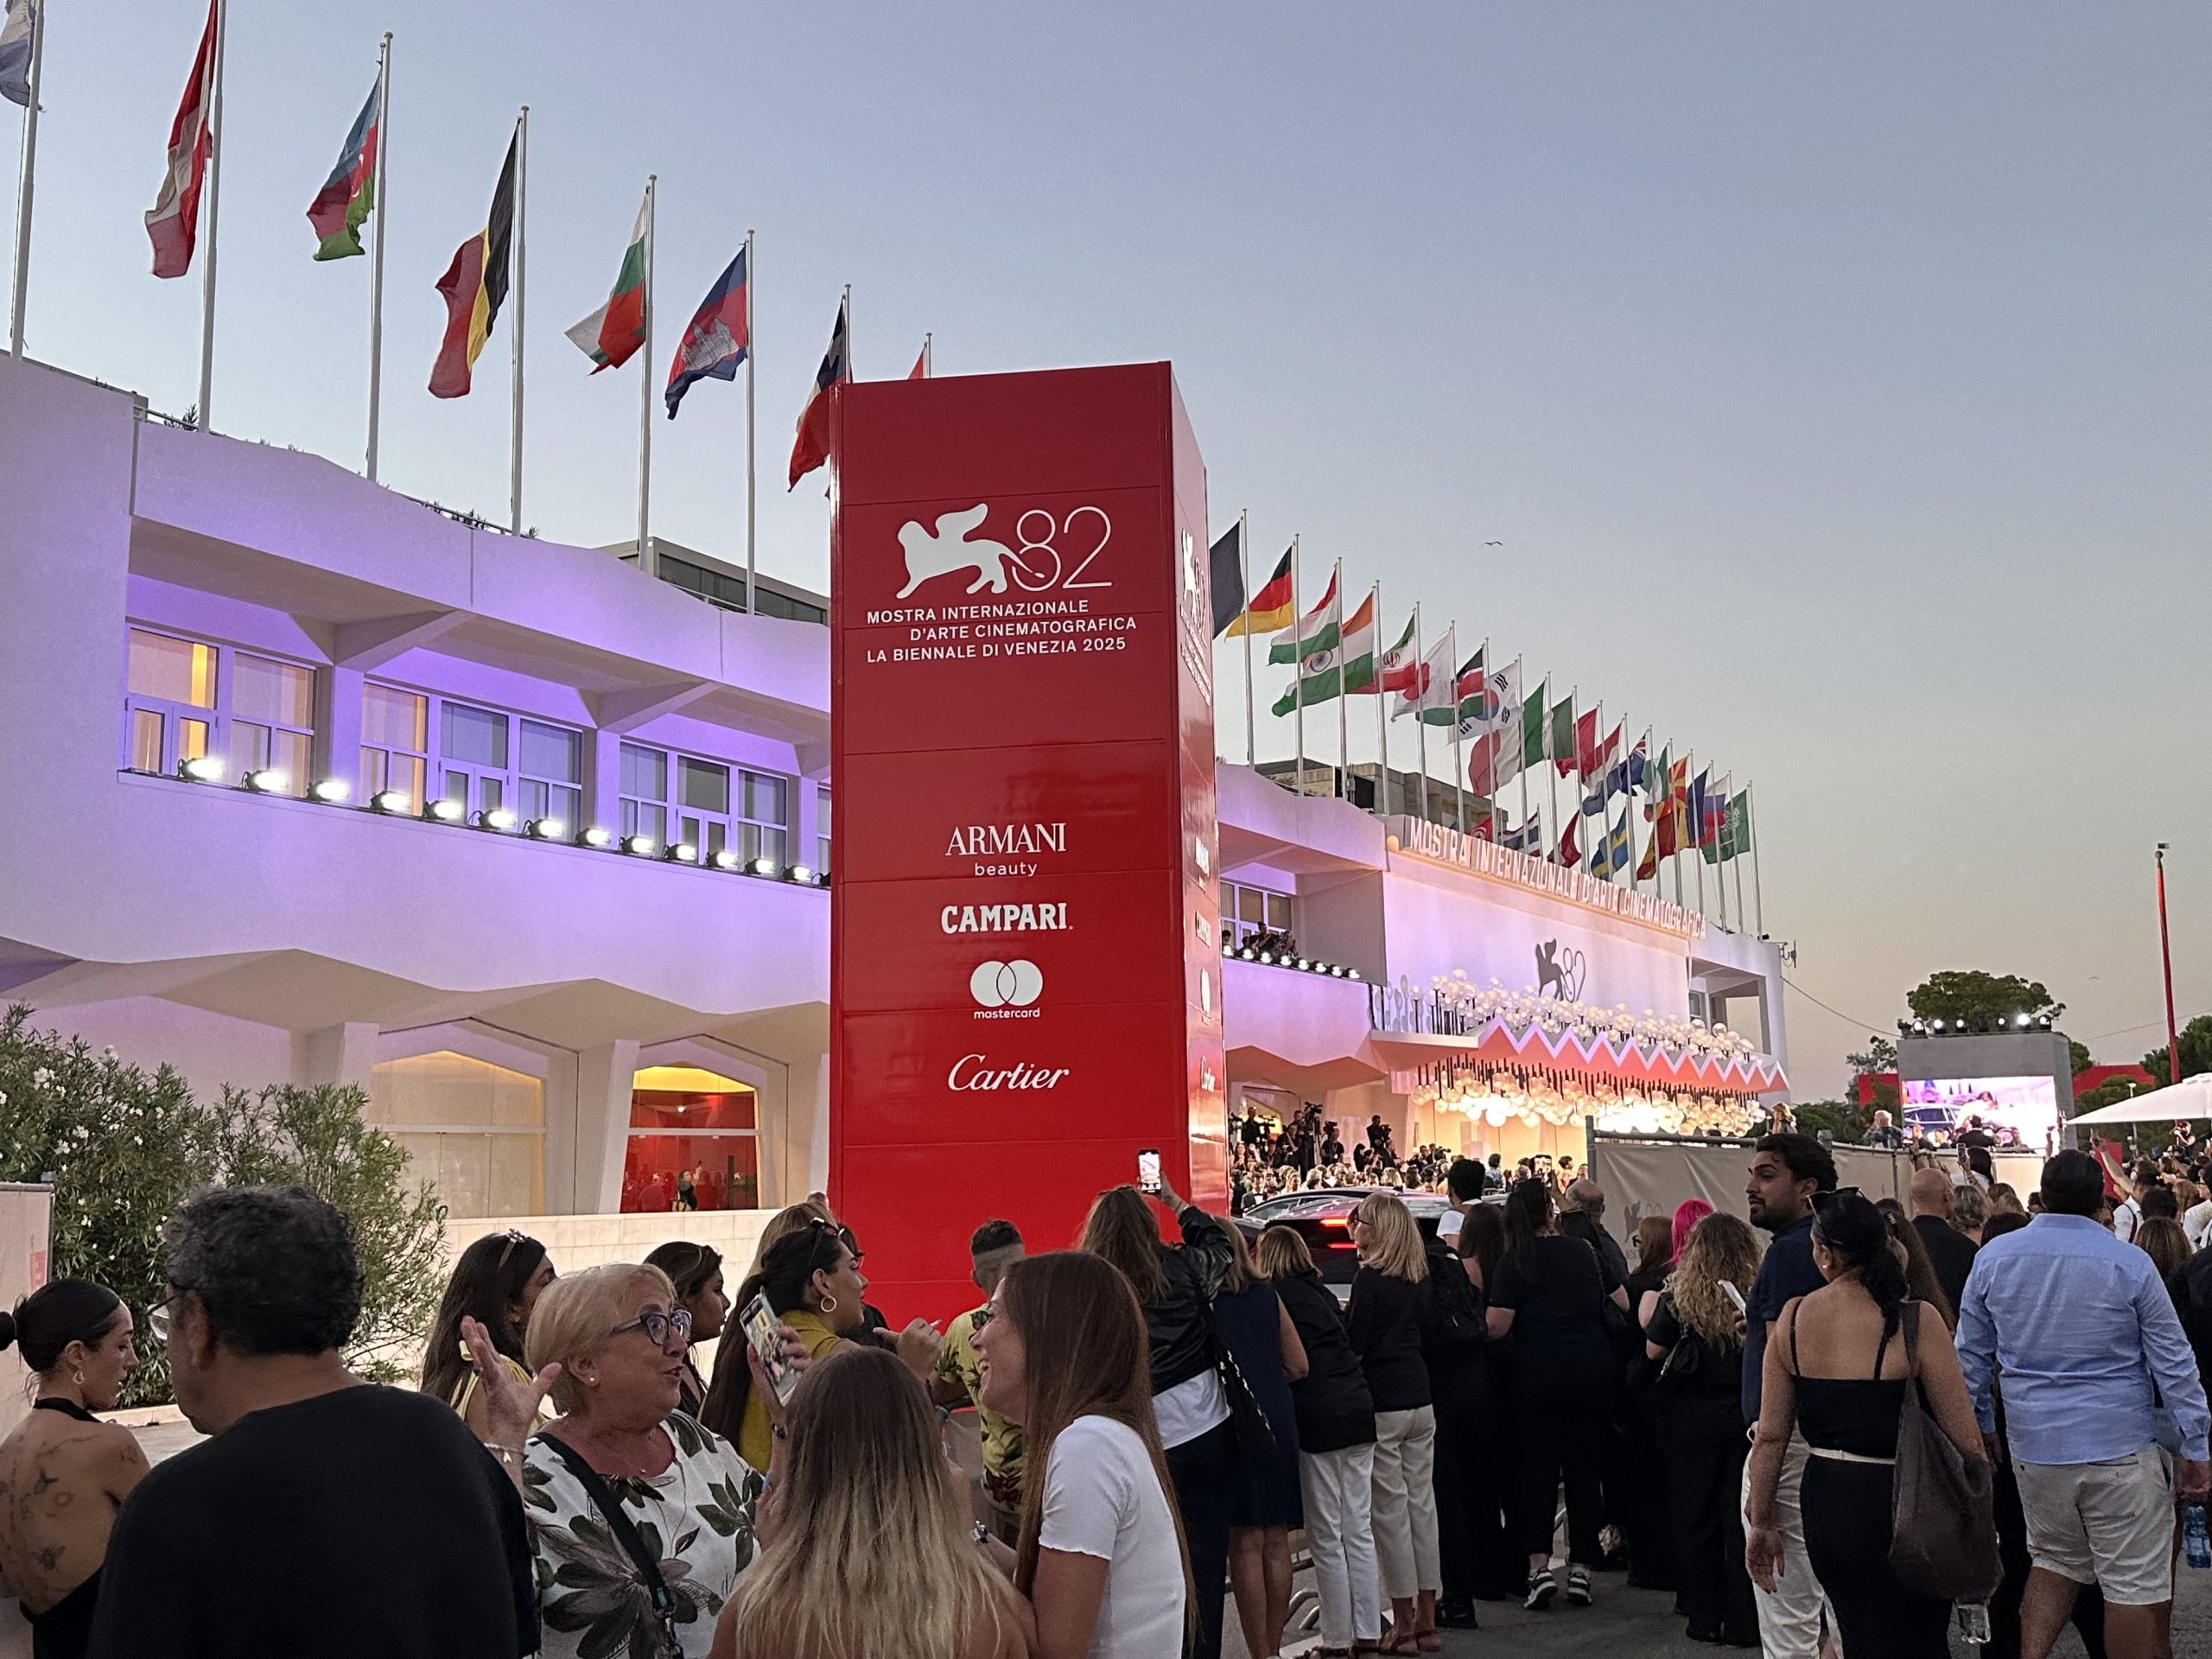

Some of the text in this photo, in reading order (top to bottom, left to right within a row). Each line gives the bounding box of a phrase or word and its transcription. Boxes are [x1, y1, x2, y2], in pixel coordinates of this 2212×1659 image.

[1012, 506, 1112, 592] 82
[867, 599, 1089, 625] MOSTRA INTERNAZIONALE
[910, 616, 1137, 641] D'ARTE CINEMATOGRAFICA
[867, 636, 1126, 664] LA BIENNALE DI VENEZIA 2025
[944, 823, 1067, 856] ARMANI
[974, 861, 1039, 878] beauty
[1410, 816, 1707, 939] MOSTRA INTERNAZIONALE D'ARTE CINEMATOGRAFICA
[1563, 948, 1586, 1003] 82
[974, 1006, 1040, 1020] mastercard
[948, 1053, 1070, 1091] Cartier
